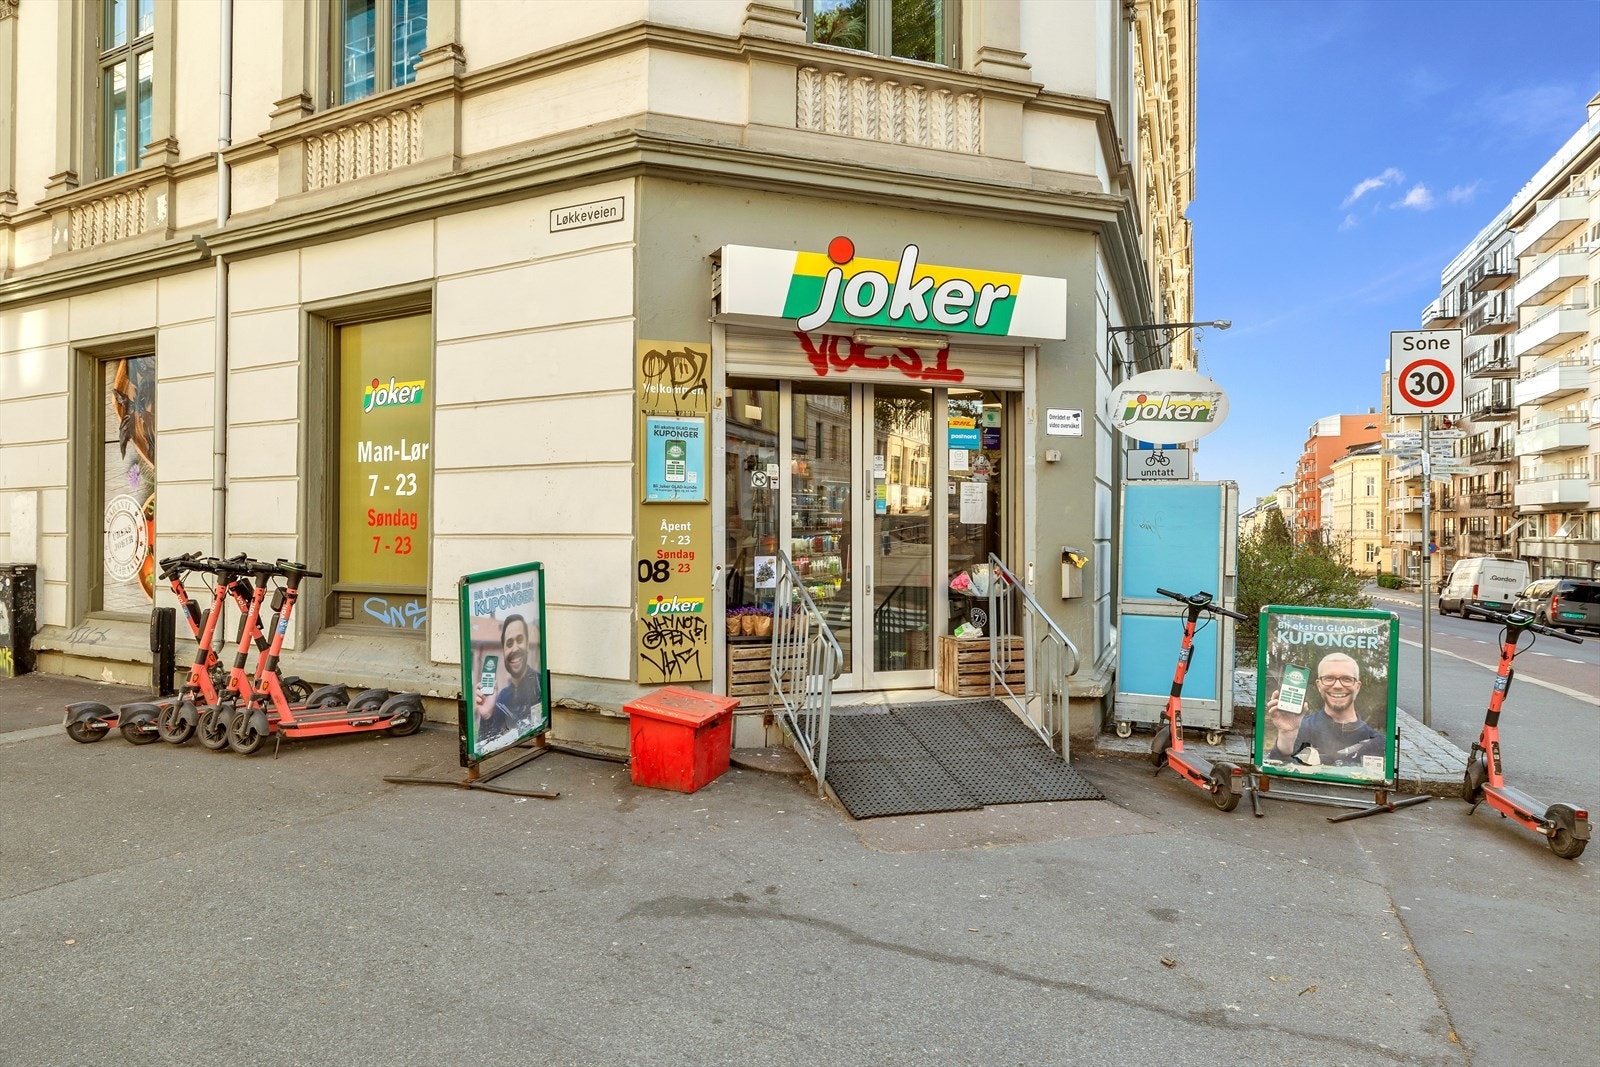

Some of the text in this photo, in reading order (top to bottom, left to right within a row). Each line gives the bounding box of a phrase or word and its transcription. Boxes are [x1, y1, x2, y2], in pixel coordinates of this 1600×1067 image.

[556, 206, 617, 226] Løkkeveien
[797, 236, 1011, 332] joker
[1403, 336, 1450, 351] Sone
[1409, 371, 1445, 396] 30
[364, 376, 420, 413] joker
[1125, 394, 1206, 425] joker
[654, 430, 698, 438] KUPONGER
[357, 438, 429, 463] Man-Lør
[1141, 469, 1174, 477] unntatt
[368, 474, 378, 497] 7
[395, 472, 417, 496] 23
[367, 508, 418, 530] Søndag
[660, 519, 691, 533] Åpent
[372, 536, 381, 554] 7
[394, 536, 412, 555] 23
[661, 536, 667, 545] 7
[678, 536, 691, 545] 23
[657, 549, 695, 561] Søndag
[638, 559, 670, 583] 08
[678, 564, 691, 573] 23
[505, 582, 521, 592] GLAD
[474, 588, 534, 616] KUPONGER
[651, 595, 700, 616] joker
[1278, 621, 1379, 635] Bli ekstra GLAD med
[1277, 630, 1379, 650] KUPONGER
